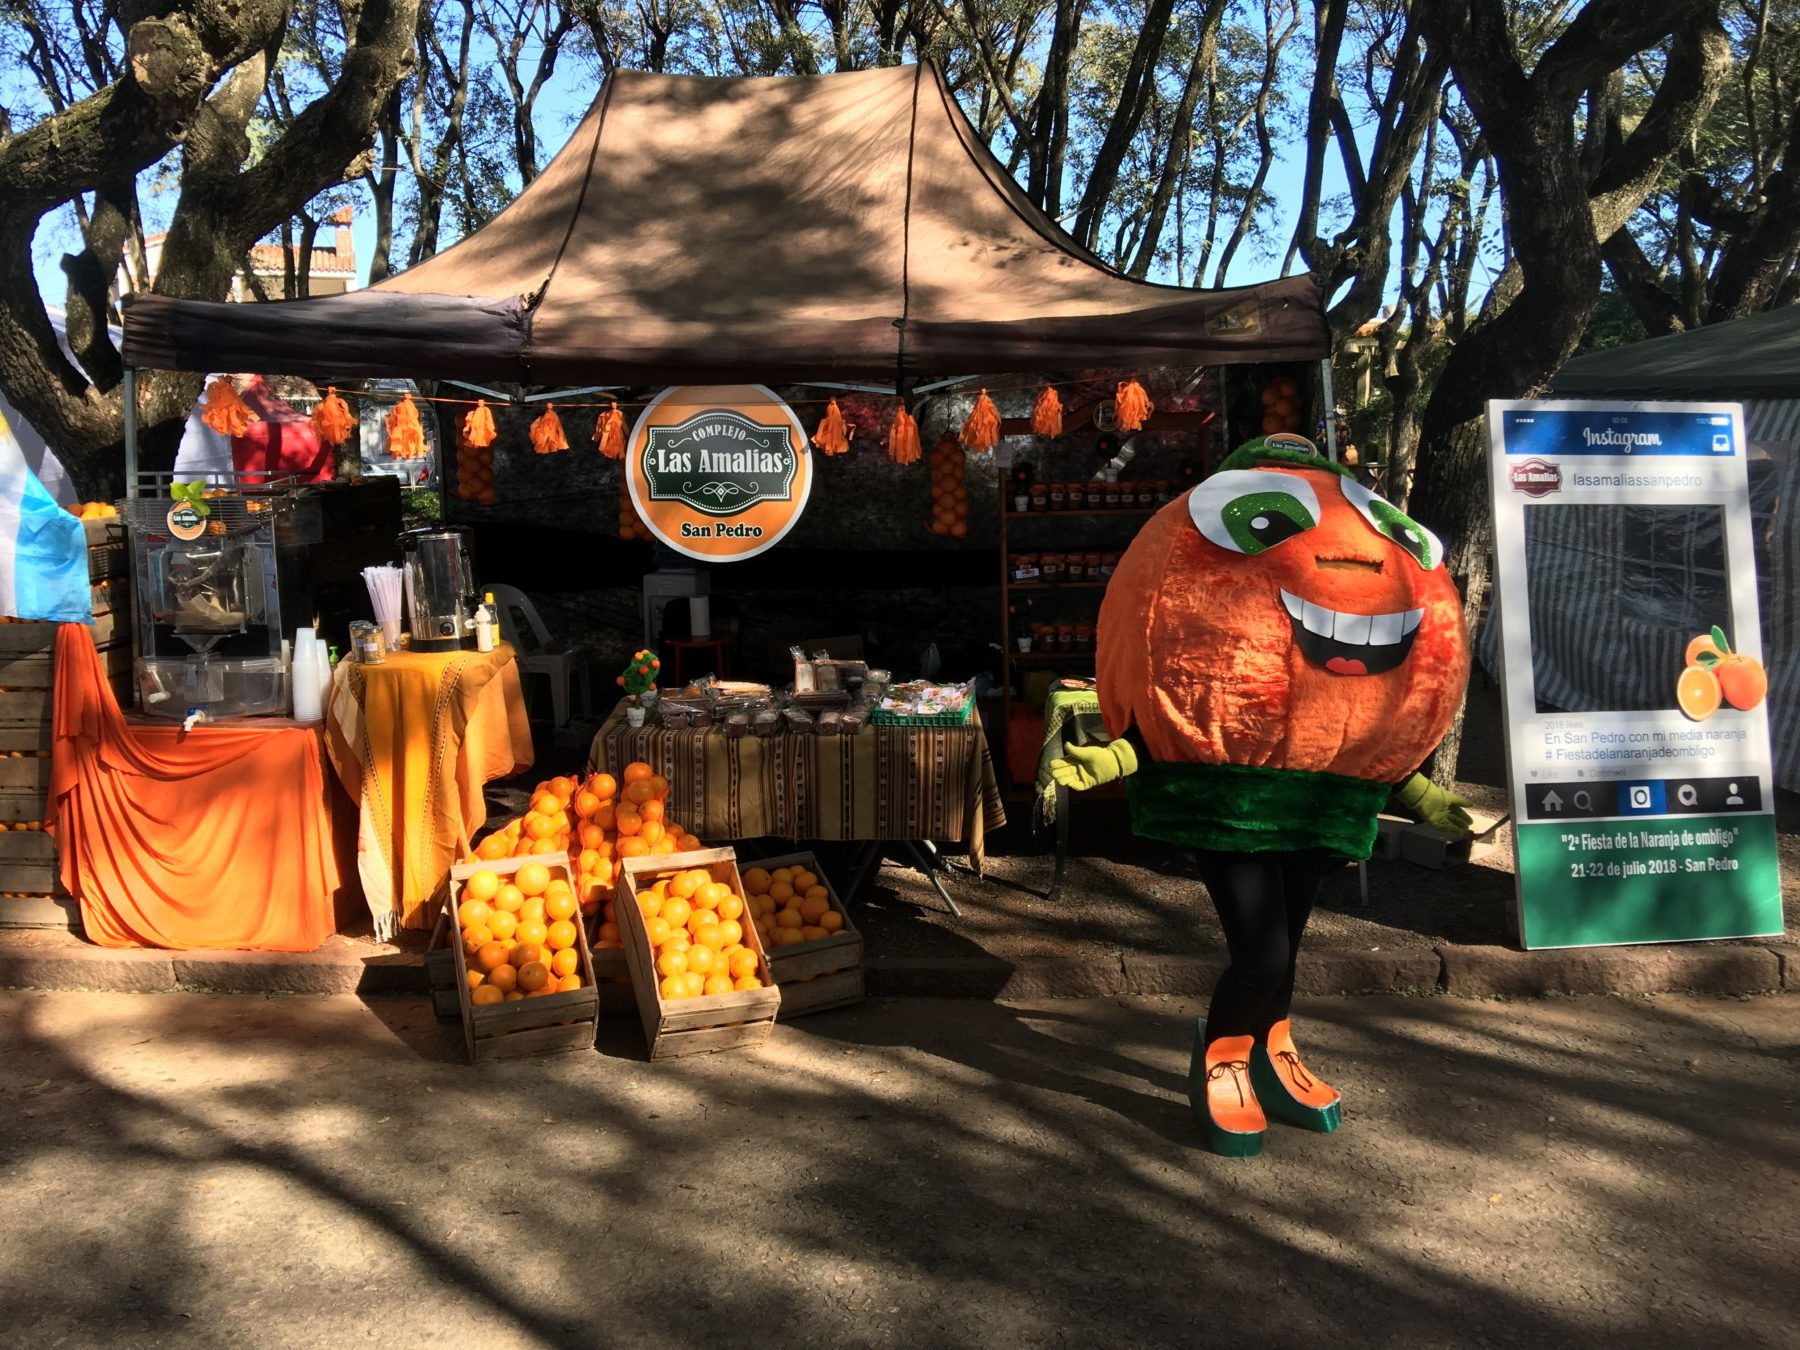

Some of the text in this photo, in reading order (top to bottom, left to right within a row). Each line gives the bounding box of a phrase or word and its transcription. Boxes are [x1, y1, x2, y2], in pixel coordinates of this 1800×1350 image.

[692, 424, 746, 441] COMPLEJO
[1583, 427, 1662, 453] Instagram
[657, 449, 783, 473] Las Amalias
[1573, 473, 1703, 488] lasamaliassanpedro
[681, 523, 763, 538] San Pedro
[1545, 727, 1747, 744] En San Pedro con mi media naranja
[1556, 746, 1716, 760] Fiestadelanaranjadeombligo
[1581, 833, 1613, 850] Fiesta
[1615, 832, 1627, 849] de
[1629, 832, 1640, 848] la
[1640, 830, 1680, 850] Naranja
[1681, 829, 1694, 846] de
[1695, 827, 1739, 848] ombligo"
[1571, 863, 1604, 878] 21-22
[1607, 862, 1620, 876] de
[1622, 860, 1646, 879] julio
[1648, 859, 1677, 874] 2018
[1685, 858, 1706, 872] San
[1707, 857, 1739, 871] Pedro
